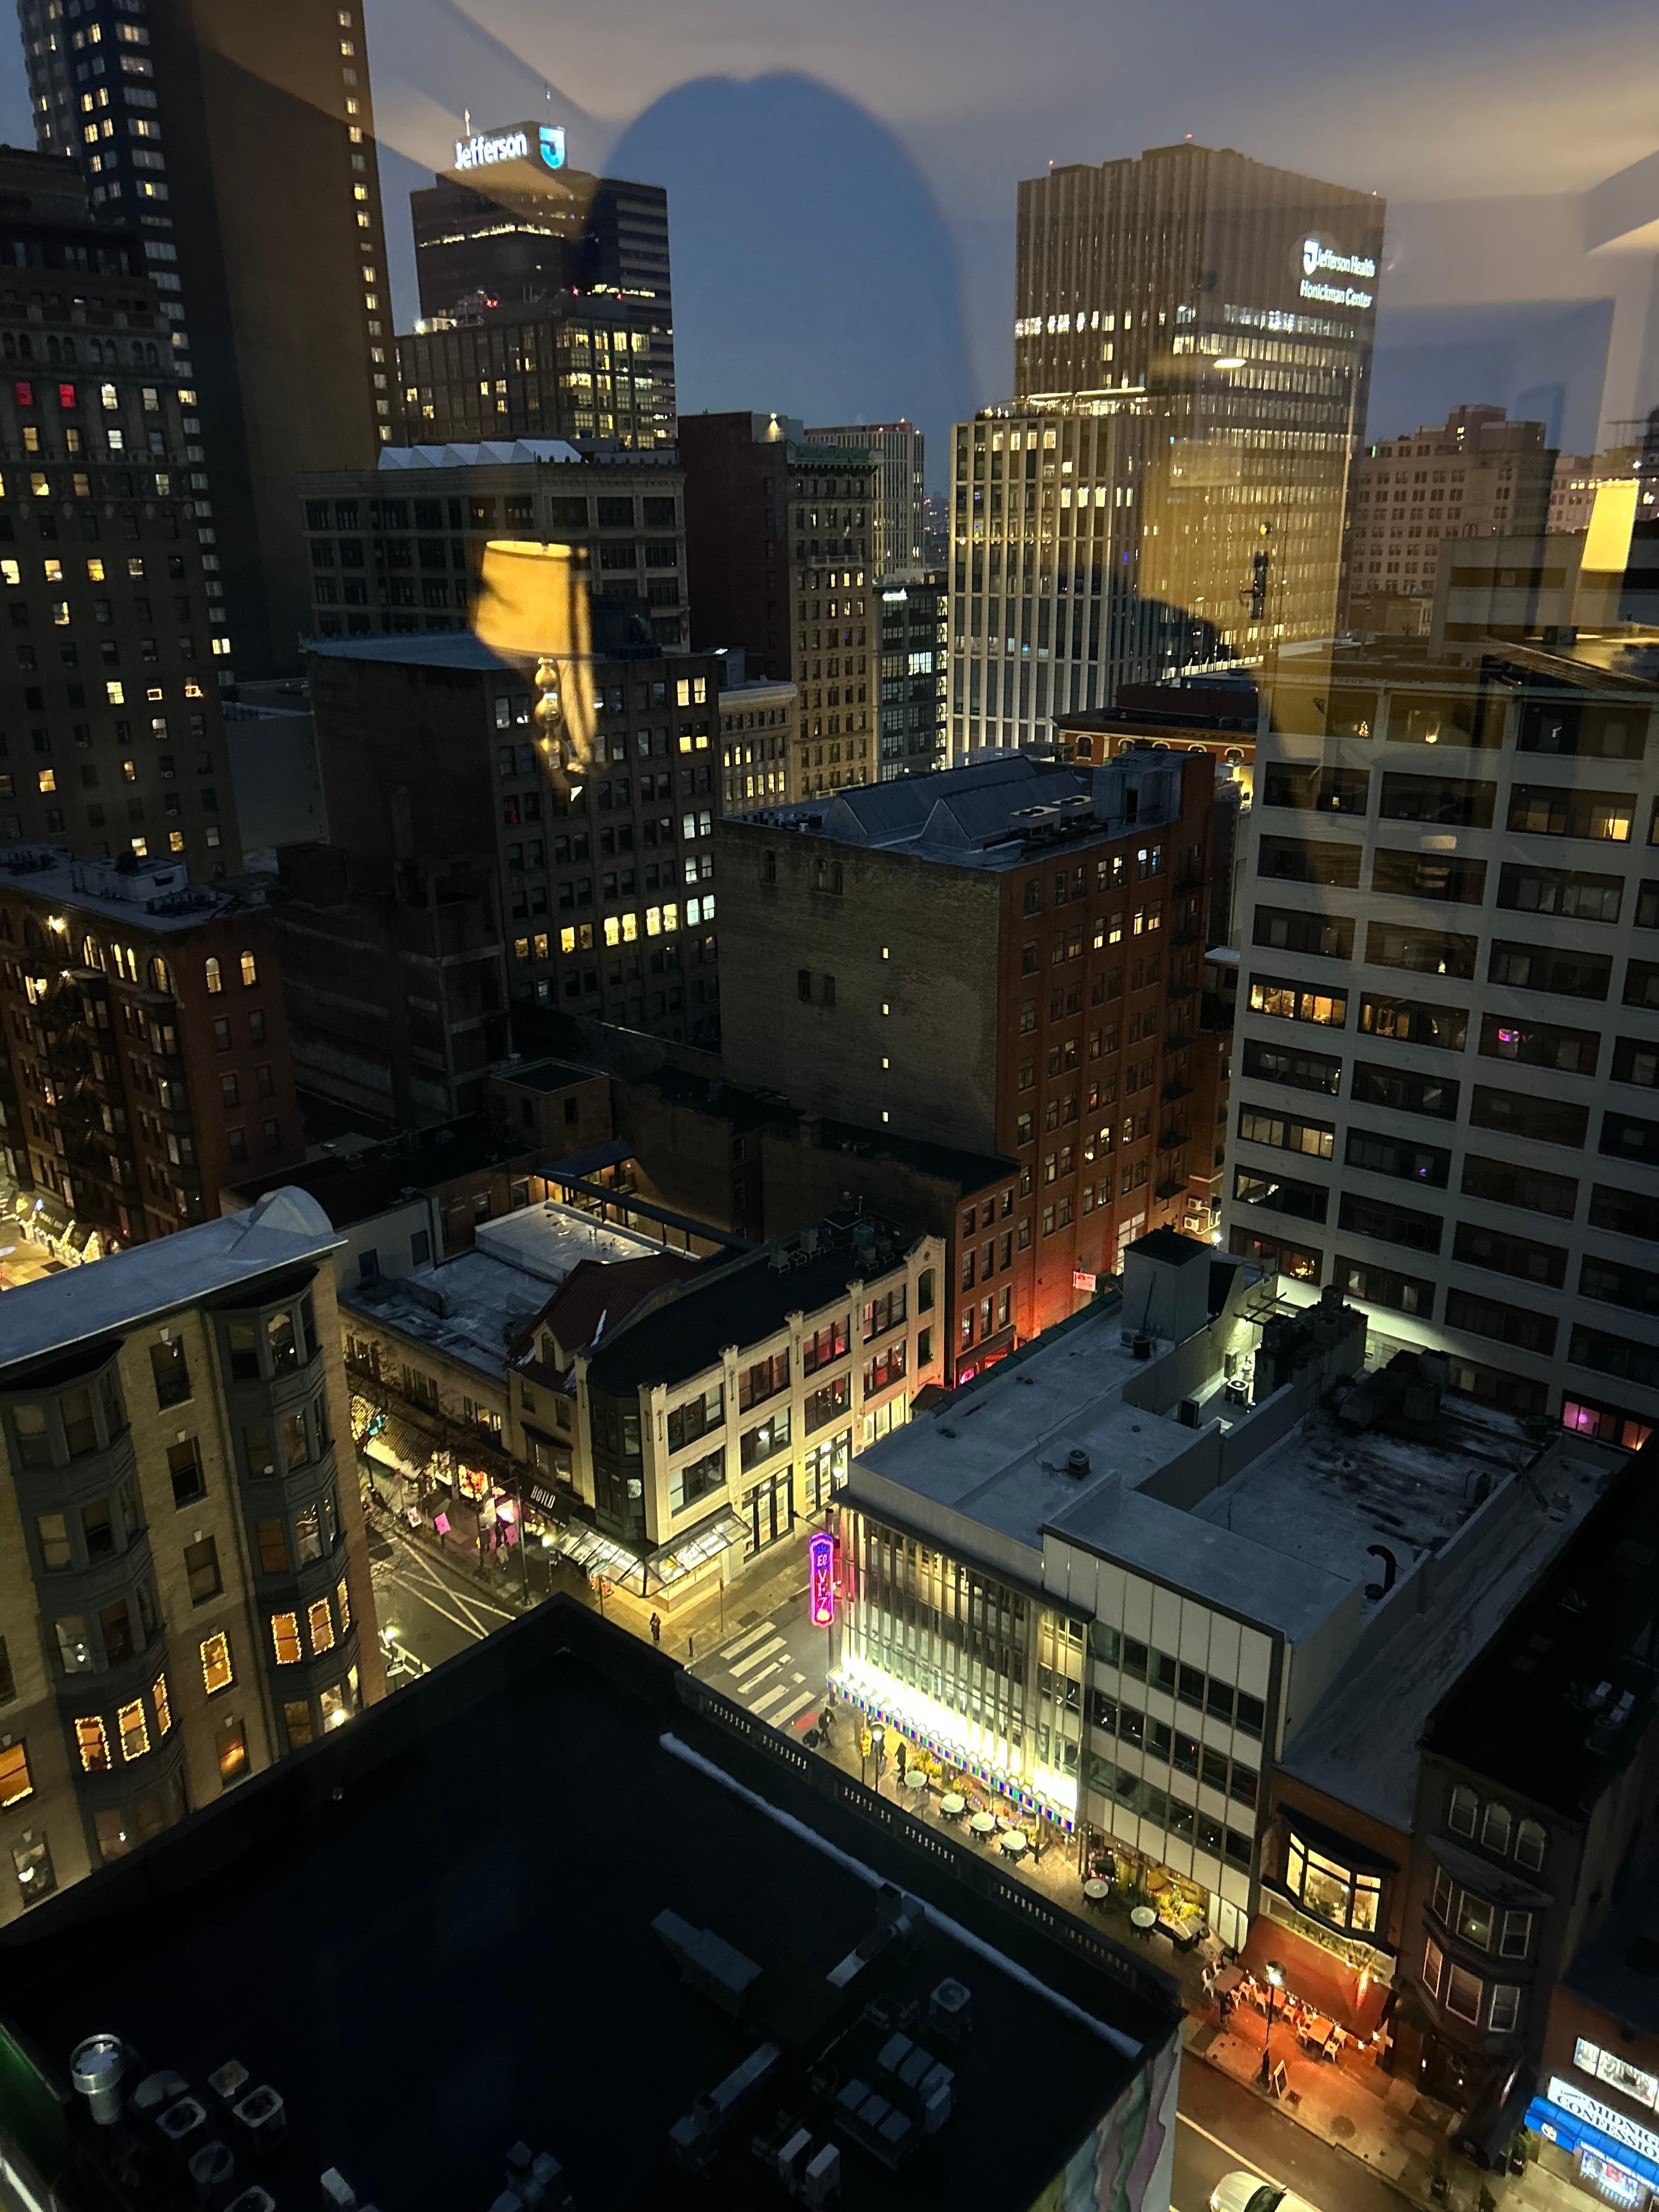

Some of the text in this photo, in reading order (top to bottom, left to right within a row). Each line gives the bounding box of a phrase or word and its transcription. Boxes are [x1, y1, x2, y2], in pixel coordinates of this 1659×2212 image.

[455, 132, 528, 170] Jefferson
[1317, 248, 1375, 277] Jefferson Health
[1300, 279, 1373, 308] Honickman Center
[1557, 2095, 1659, 2159] CONFESSIO
[1588, 2101, 1659, 2147] MIDNIG
